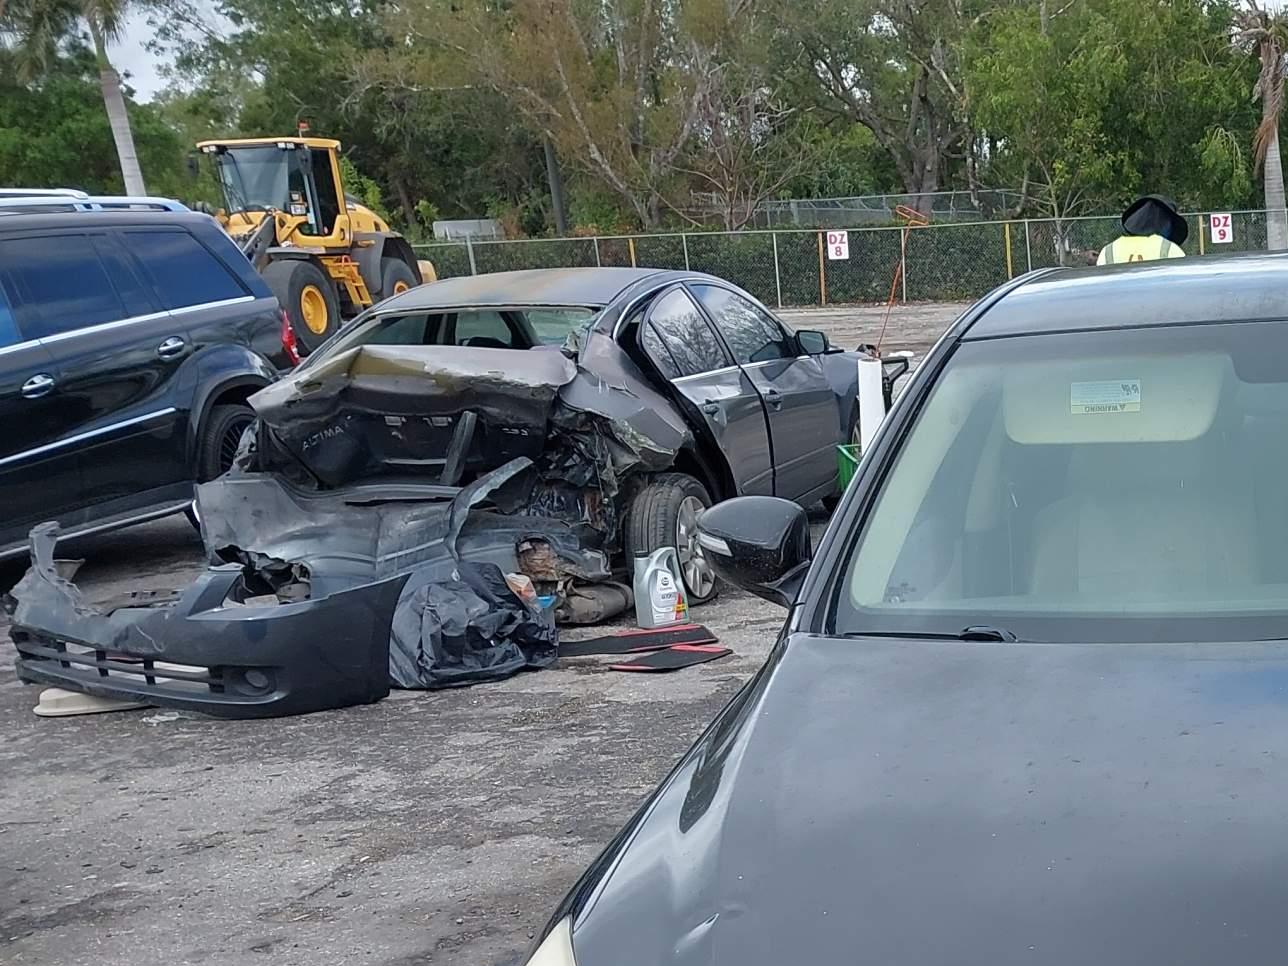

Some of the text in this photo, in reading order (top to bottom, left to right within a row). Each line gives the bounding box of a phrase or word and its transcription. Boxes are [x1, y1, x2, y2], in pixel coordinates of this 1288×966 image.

[1212, 215, 1230, 228] DZ
[829, 233, 846, 245] DZ
[1218, 229, 1226, 240] 9
[835, 246, 842, 257] 8
[302, 425, 345, 451] ALTIMA
